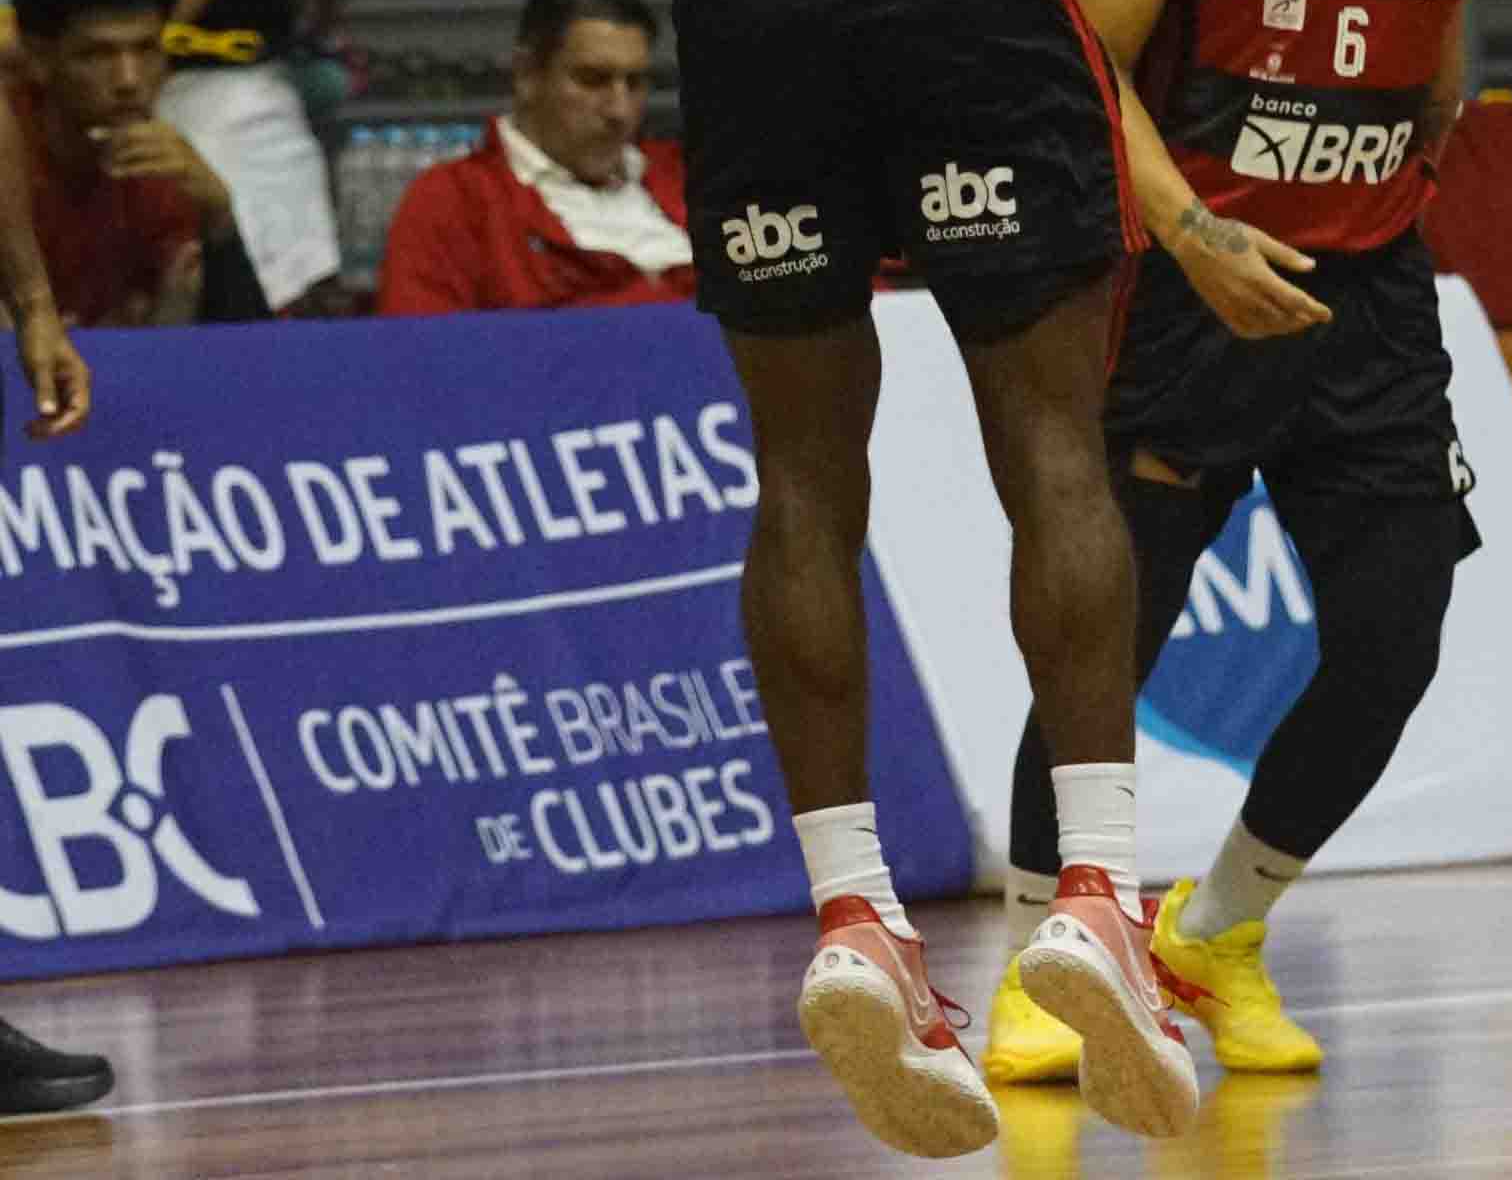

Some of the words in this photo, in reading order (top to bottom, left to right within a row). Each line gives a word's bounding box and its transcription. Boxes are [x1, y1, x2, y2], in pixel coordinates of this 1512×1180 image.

[1332, 5, 1371, 79] 6
[1250, 93, 1318, 118] banco
[1300, 121, 1414, 185] BRB
[920, 161, 1018, 223] abc
[721, 203, 824, 266] abc
[942, 218, 1021, 242] construção
[753, 251, 829, 282] construção
[0, 452, 287, 607] MAÇÃO
[287, 455, 421, 566] DE
[424, 401, 761, 555] ATLETAS
[298, 672, 555, 796] COMITÊ
[477, 812, 532, 866] DE
[530, 757, 776, 876] CLUBES
